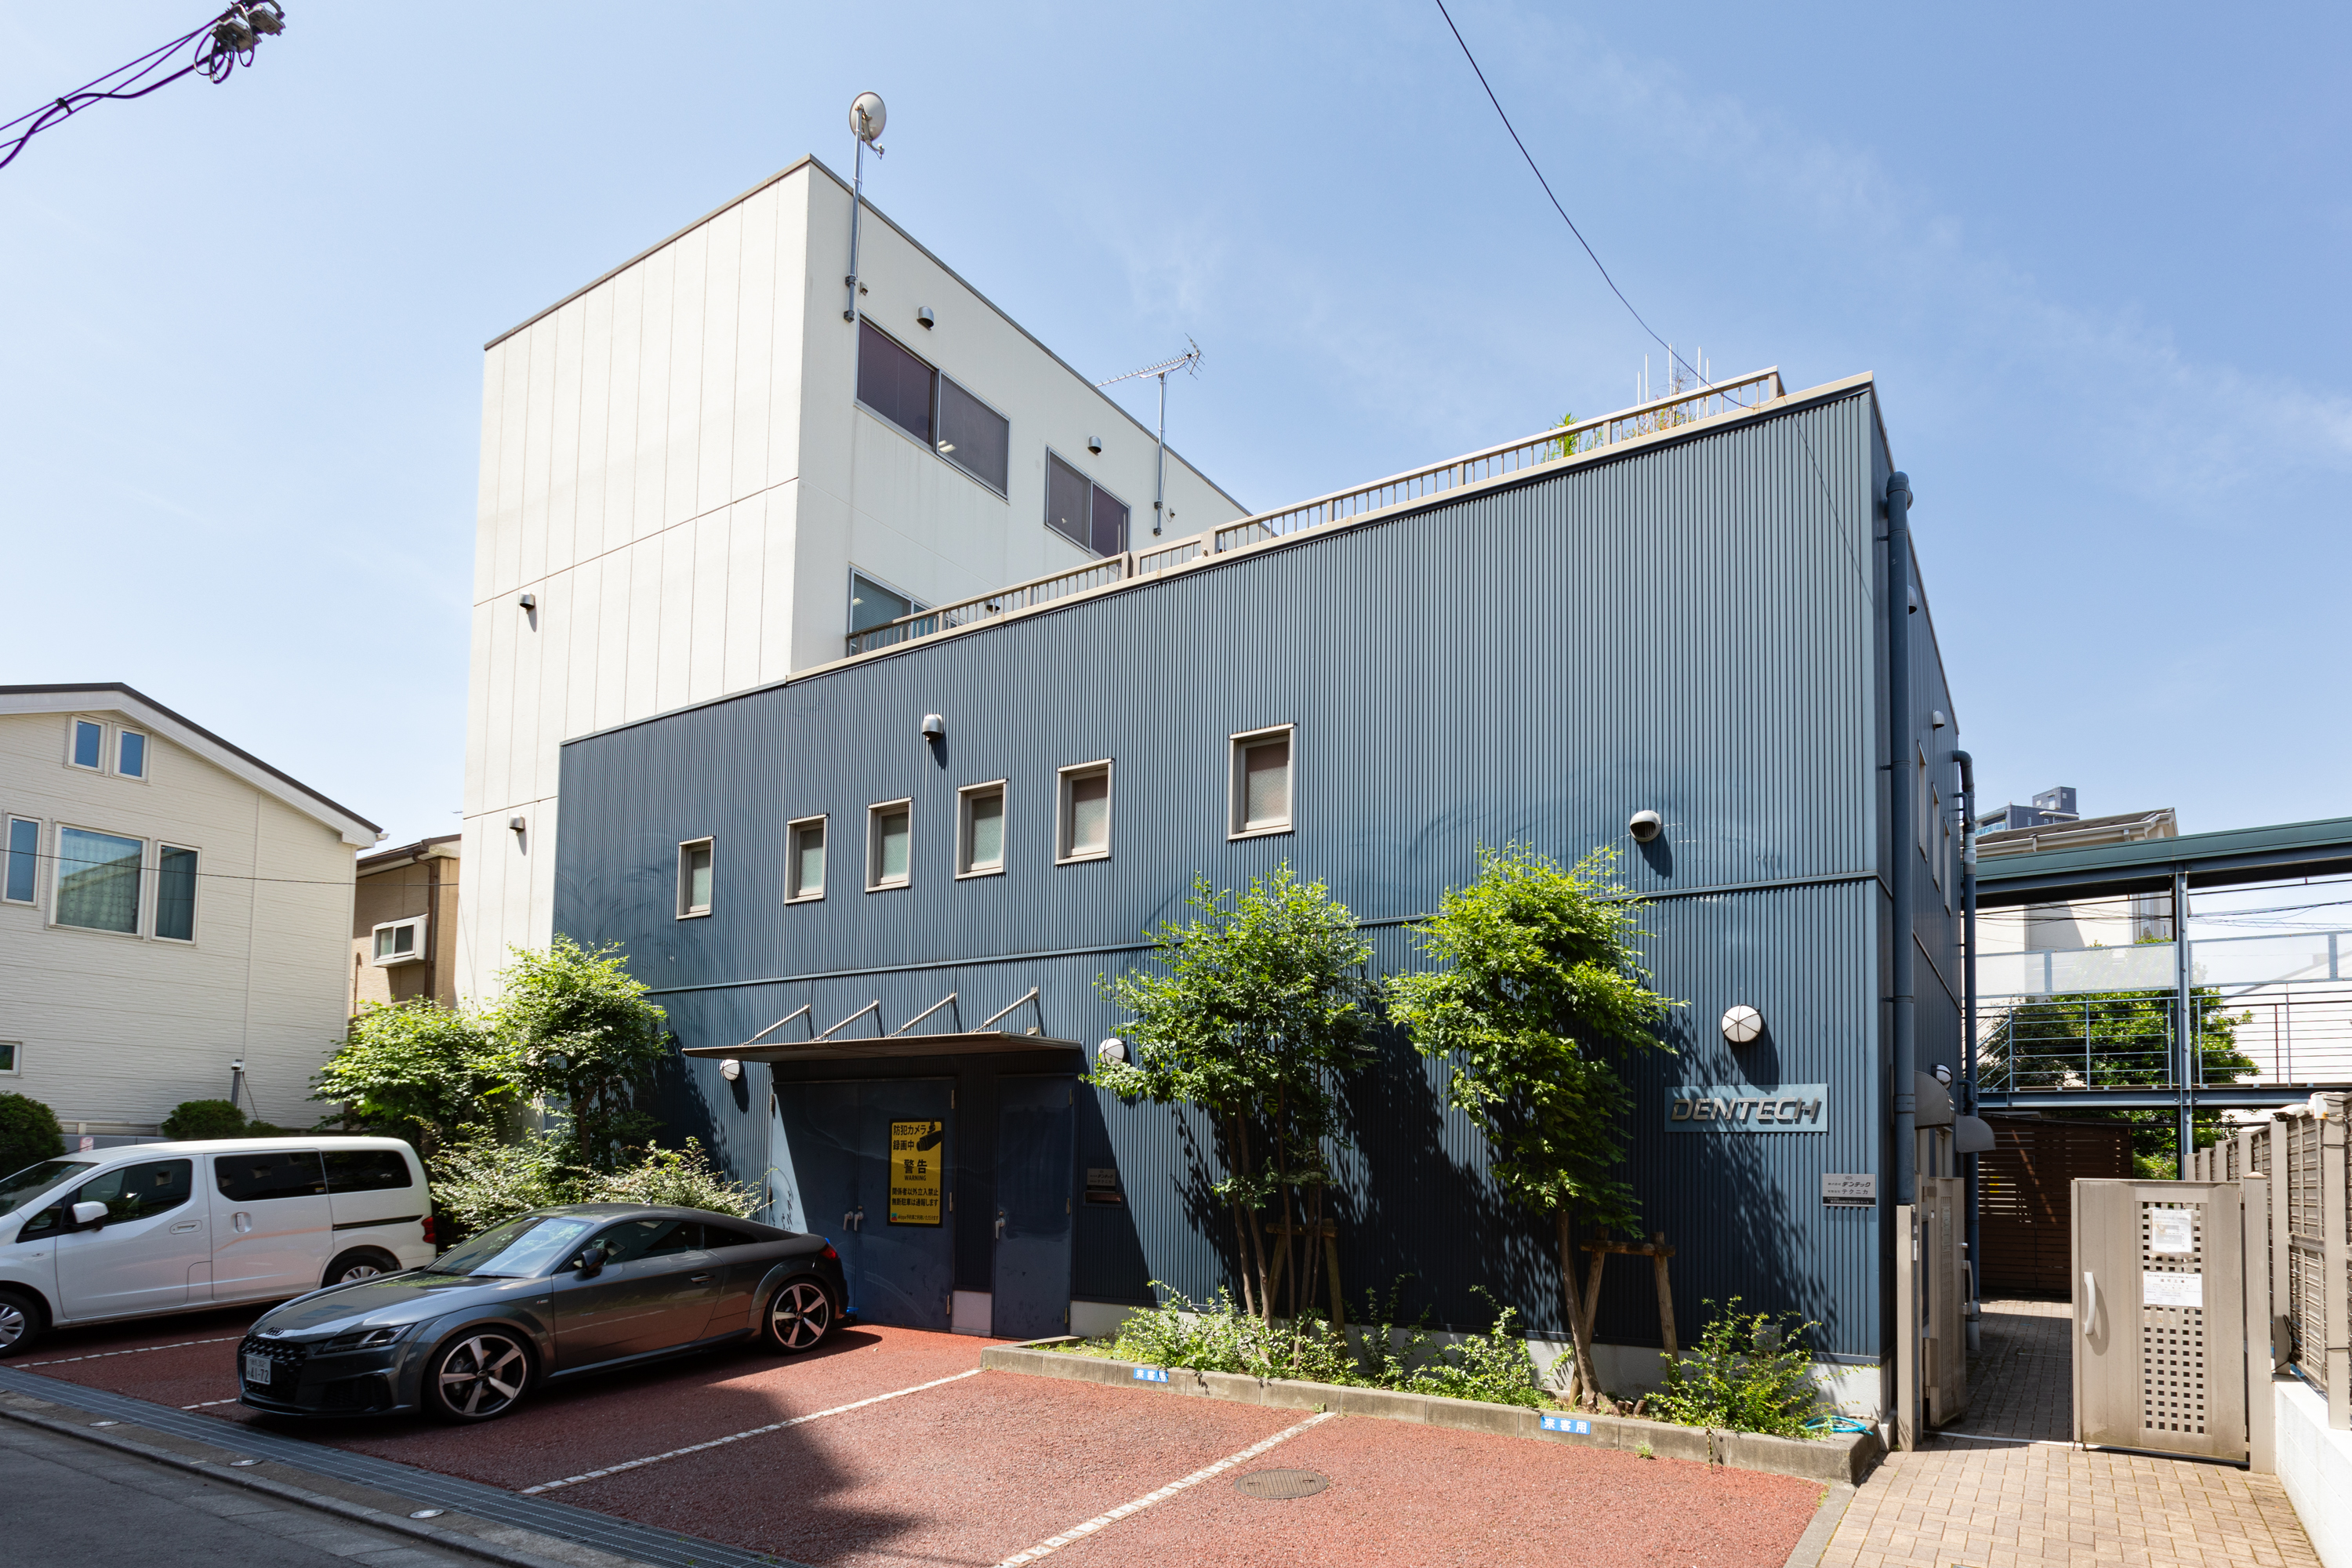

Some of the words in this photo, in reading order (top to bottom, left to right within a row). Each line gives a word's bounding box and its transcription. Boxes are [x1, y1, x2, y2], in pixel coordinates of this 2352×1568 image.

[1671, 1097, 1819, 1120] DENTECH
[893, 1124, 927, 1136] 防犯カメラ
[893, 1139, 914, 1151] 録画中
[904, 1159, 927, 1174] 警告
[891, 1187, 938, 1196] 関係者以外立入禁止
[891, 1197, 938, 1207] 無断駐車は通報します
[1136, 1369, 1167, 1382] 来客用
[1544, 1417, 1588, 1433] 来客用
